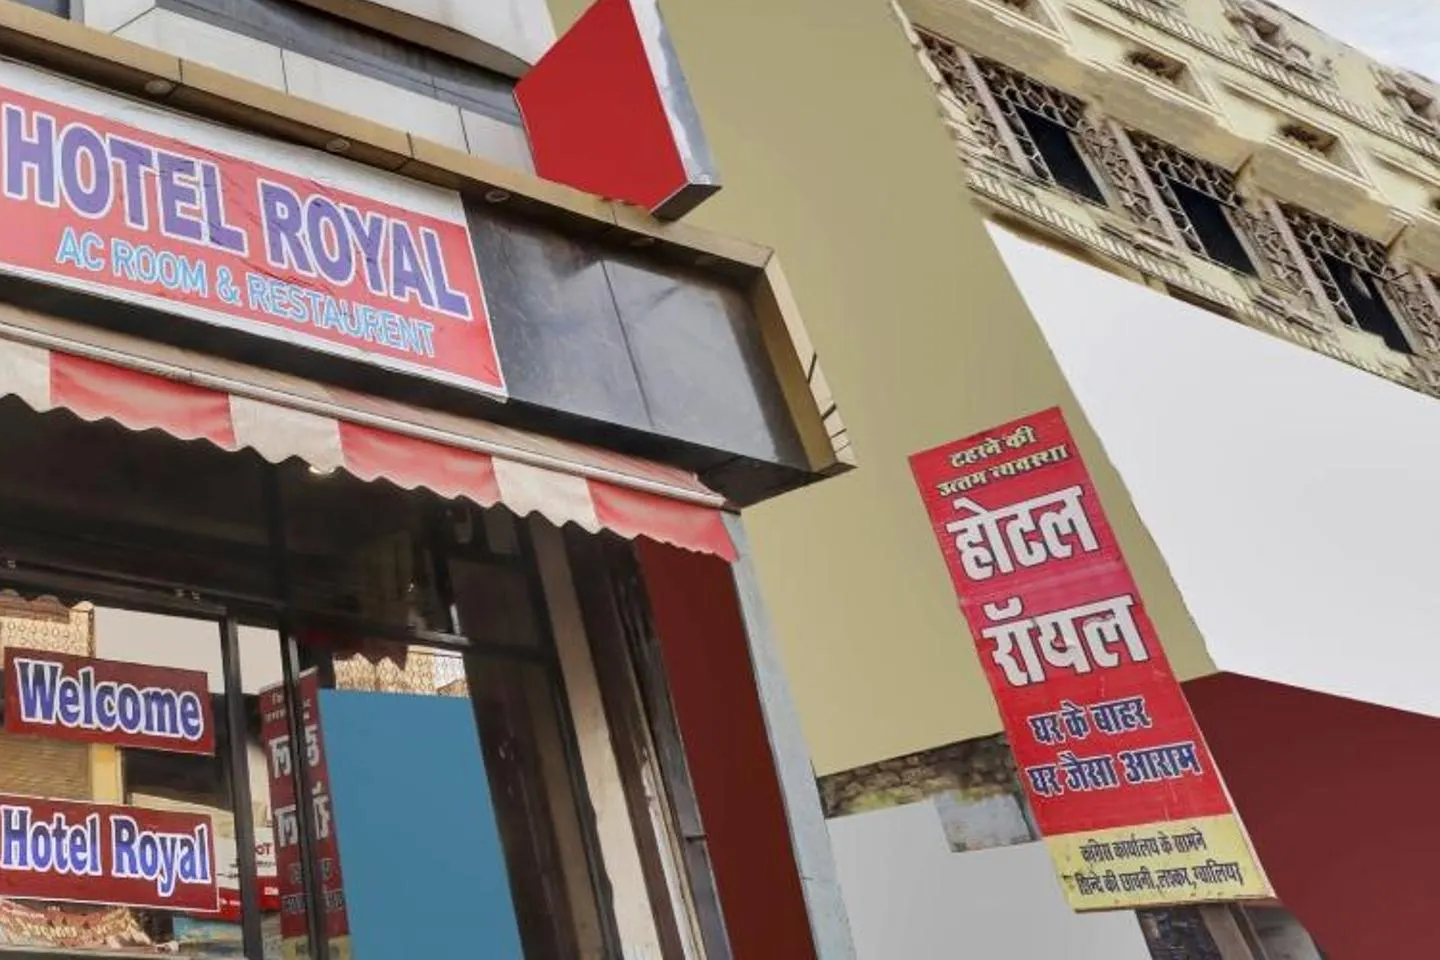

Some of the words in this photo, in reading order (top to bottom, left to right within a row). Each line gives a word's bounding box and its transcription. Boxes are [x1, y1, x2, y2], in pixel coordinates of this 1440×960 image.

[2, 103, 248, 256] HOTEL
[259, 178, 472, 320] ROYAL
[56, 227, 105, 271] AC
[112, 239, 208, 299] ROOM
[215, 266, 240, 307] &
[247, 273, 435, 358] RESTAURENT
[946, 485, 1099, 581] होटल
[981, 593, 1150, 686] रॉयल
[13, 656, 206, 741] Welcome
[1027, 712, 1066, 744] घर
[1060, 698, 1089, 739] के
[1089, 695, 1152, 735] बाहर
[1026, 764, 1064, 798] घर
[1057, 751, 1120, 793] जैसा
[1117, 740, 1203, 784] आराम
[0, 803, 102, 876] Hotel
[111, 814, 212, 898] Royal
